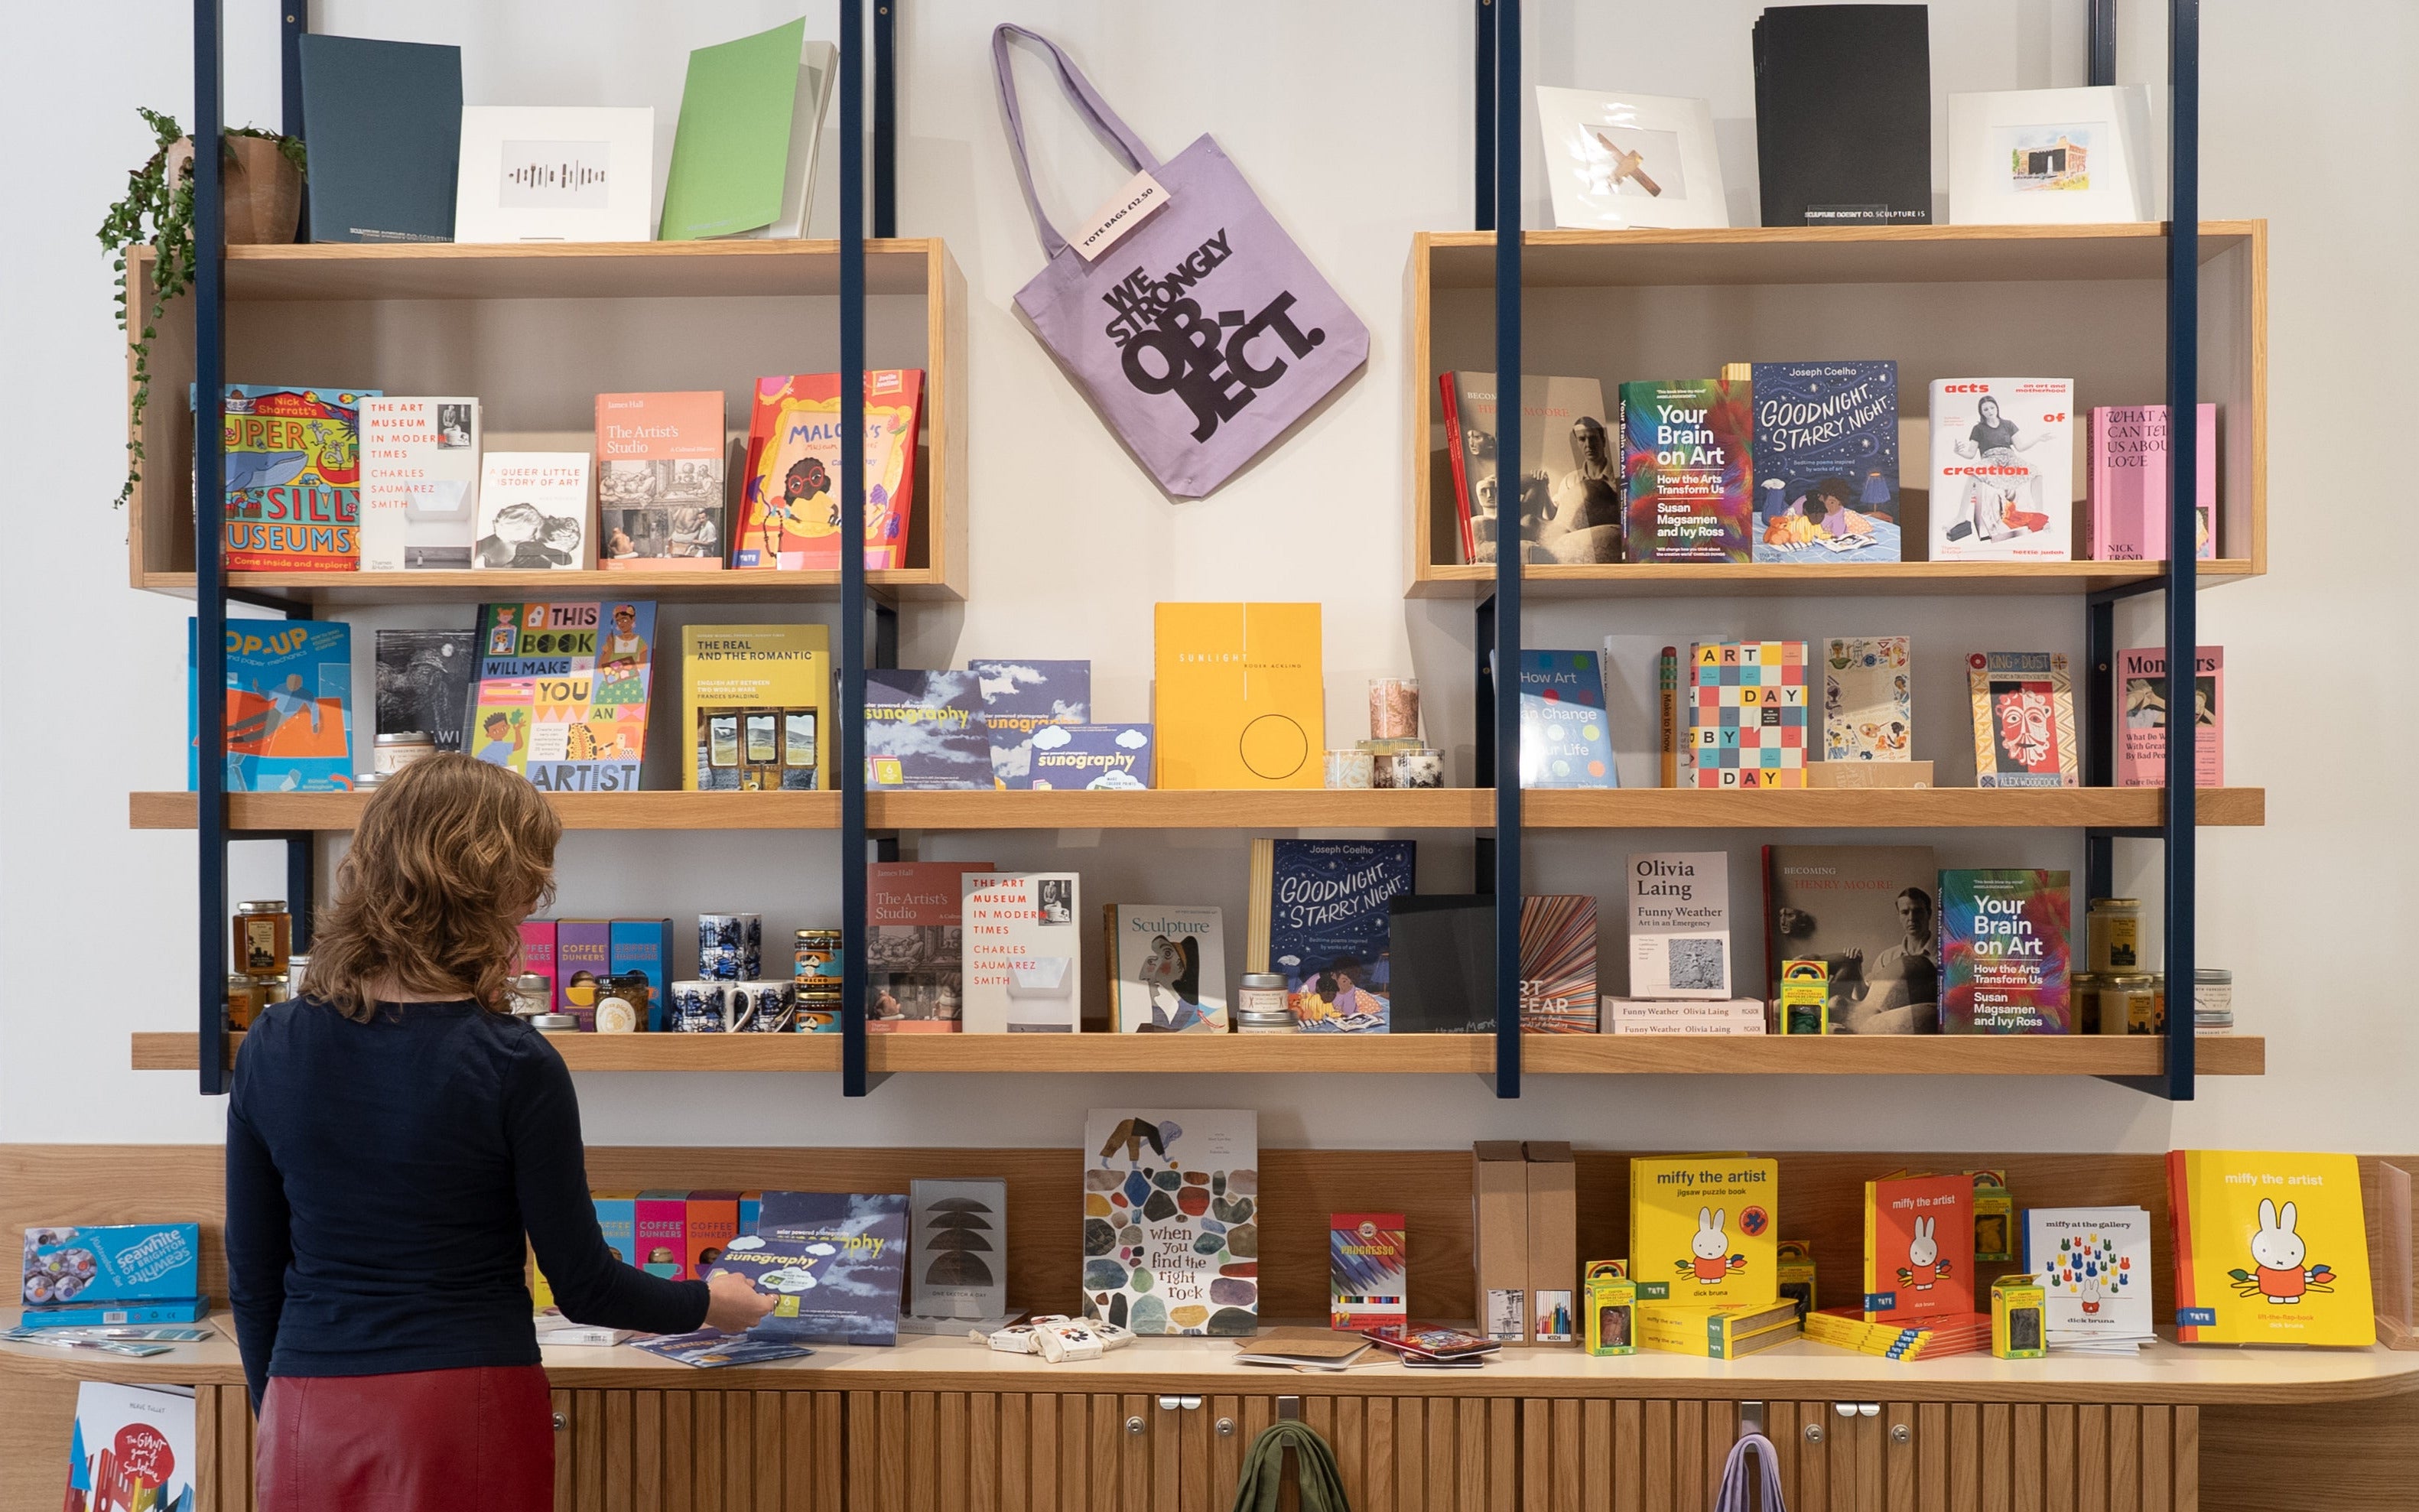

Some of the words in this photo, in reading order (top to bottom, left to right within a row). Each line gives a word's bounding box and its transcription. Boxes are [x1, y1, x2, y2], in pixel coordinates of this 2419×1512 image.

[1083, 226, 1106, 247] TOTE
[1104, 209, 1127, 229] BAGS
[1127, 187, 1153, 210] £12.50
[1101, 265, 1156, 313] WE
[1106, 227, 1233, 348] STRONGLY
[1190, 290, 1326, 444] JECT.
[1790, 367, 1822, 377] Joseph
[1824, 366, 1857, 376] Coelho
[1945, 383, 1989, 393] acts
[275, 396, 301, 407] Nick
[371, 403, 395, 412] THE
[400, 403, 423, 412] ART
[1761, 382, 1873, 428] GOODNIGHT,
[1657, 405, 1708, 424] Your
[2043, 412, 2065, 422] of
[2106, 410, 2155, 423] WHAT
[371, 419, 425, 428] MUSEUM
[607, 425, 632, 438] The
[632, 424, 678, 438] Artist's
[1657, 426, 1714, 444] Brain
[371, 434, 385, 443] IN
[392, 434, 447, 443] MODERN
[606, 441, 649, 454] Studio
[371, 450, 408, 458] TIMES
[1657, 450, 1686, 465] on
[1690, 447, 1725, 465] Art
[2107, 455, 2148, 467] LOVE
[371, 469, 424, 478] CHARLES
[1943, 465, 2029, 476] creation
[1657, 476, 1679, 484] How
[1682, 475, 1698, 484] the
[1700, 475, 1722, 484] Arts
[371, 484, 434, 493] SAUMAREZ
[1657, 485, 1709, 494] Transform
[1711, 485, 1724, 494] Us
[372, 500, 408, 509] SMITH
[1657, 503, 1690, 512] Susan
[1657, 515, 1717, 526] Magsamen
[227, 524, 351, 553] USEUMS
[1657, 527, 1677, 537] and
[1680, 527, 1696, 539] Ivy
[1699, 527, 1724, 537] Ross
[2108, 544, 2133, 552] NICK
[234, 557, 261, 568] Come
[263, 558, 291, 568] inside
[294, 558, 312, 568] and
[314, 559, 352, 571] explore!
[552, 607, 597, 626] THIS
[522, 633, 594, 654] BOOK
[697, 641, 720, 649] THE
[723, 641, 752, 649] REAL
[697, 652, 722, 661] AND
[724, 652, 746, 660] THE
[750, 651, 812, 660] ROMANTIC
[1179, 654, 1248, 662] SUNLIGHT
[486, 661, 518, 675] WILL
[522, 661, 570, 675] MAKE
[1521, 672, 1553, 683] How
[1555, 672, 1577, 683] Art
[540, 681, 589, 702] YOU
[1663, 694, 1671, 714] Make
[593, 708, 614, 719] AN
[864, 704, 969, 729] sunography
[1564, 744, 1588, 756] Life
[1038, 751, 1136, 772] sunography
[533, 765, 636, 792] ARTIST
[1309, 845, 1340, 855] Joseph
[1342, 845, 1374, 854] Coelho
[1636, 860, 1695, 876] Olivia
[1280, 862, 1389, 904] GOODNIGHT,
[1794, 880, 1839, 889] HENRY
[1844, 880, 1894, 889] MOORE
[1637, 880, 1692, 900] Laing
[876, 893, 901, 905] The
[902, 893, 948, 905] Artist's
[974, 895, 1027, 903] MUSEUM
[1974, 895, 2025, 915] Your
[876, 907, 917, 919] Studio
[1637, 907, 1673, 919] Funny
[1676, 907, 1722, 917] Weather
[1132, 917, 1210, 938] Sculpture
[1974, 916, 2032, 935] Brain
[974, 945, 1026, 954] CHARLES
[1974, 940, 2002, 955] on
[2008, 938, 2043, 955] Art
[1974, 965, 1997, 974] How
[1999, 964, 2016, 974] the
[2018, 964, 2040, 974] Arts
[974, 977, 1010, 985] SMITH
[1974, 975, 2027, 984] Transform
[2029, 975, 2043, 984] Us
[1974, 993, 2008, 1003] Susan
[1974, 1004, 2036, 1016] Magsamen
[1974, 1016, 1995, 1026] and
[1998, 1016, 2014, 1029] Ivy
[2016, 1016, 2043, 1026] Ross
[1657, 1170, 1694, 1186] miffy
[1699, 1170, 1722, 1183] the
[1728, 1169, 1766, 1182] artist
[2225, 1172, 2258, 1186] miffy
[2261, 1172, 2284, 1185] the
[2287, 1172, 2323, 1186] artist
[1892, 1197, 1915, 1210] miffy
[1917, 1195, 1930, 1207] the
[1933, 1195, 1956, 1206] artist
[2046, 1220, 2069, 1230] miffy
[2099, 1220, 2131, 1230] gallery
[1149, 1226, 1192, 1240] when
[117, 1229, 181, 1269] seawhite
[1162, 1243, 1188, 1255] you
[1341, 1245, 1394, 1255] PROGRESSO
[123, 1263, 135, 1275] OF
[137, 1239, 186, 1267] BRIGHTON
[724, 1251, 819, 1270] sunography
[1152, 1252, 1182, 1268] find
[1185, 1256, 1207, 1268] the
[1159, 1270, 1195, 1285] right
[1168, 1286, 1204, 1300] rock
[1334, 1311, 1351, 1328] 12
[2189, 1312, 2210, 1321] TATE
[2258, 1313, 2314, 1322] lift-the-flap-book
[137, 1432, 167, 1450] GIANT
